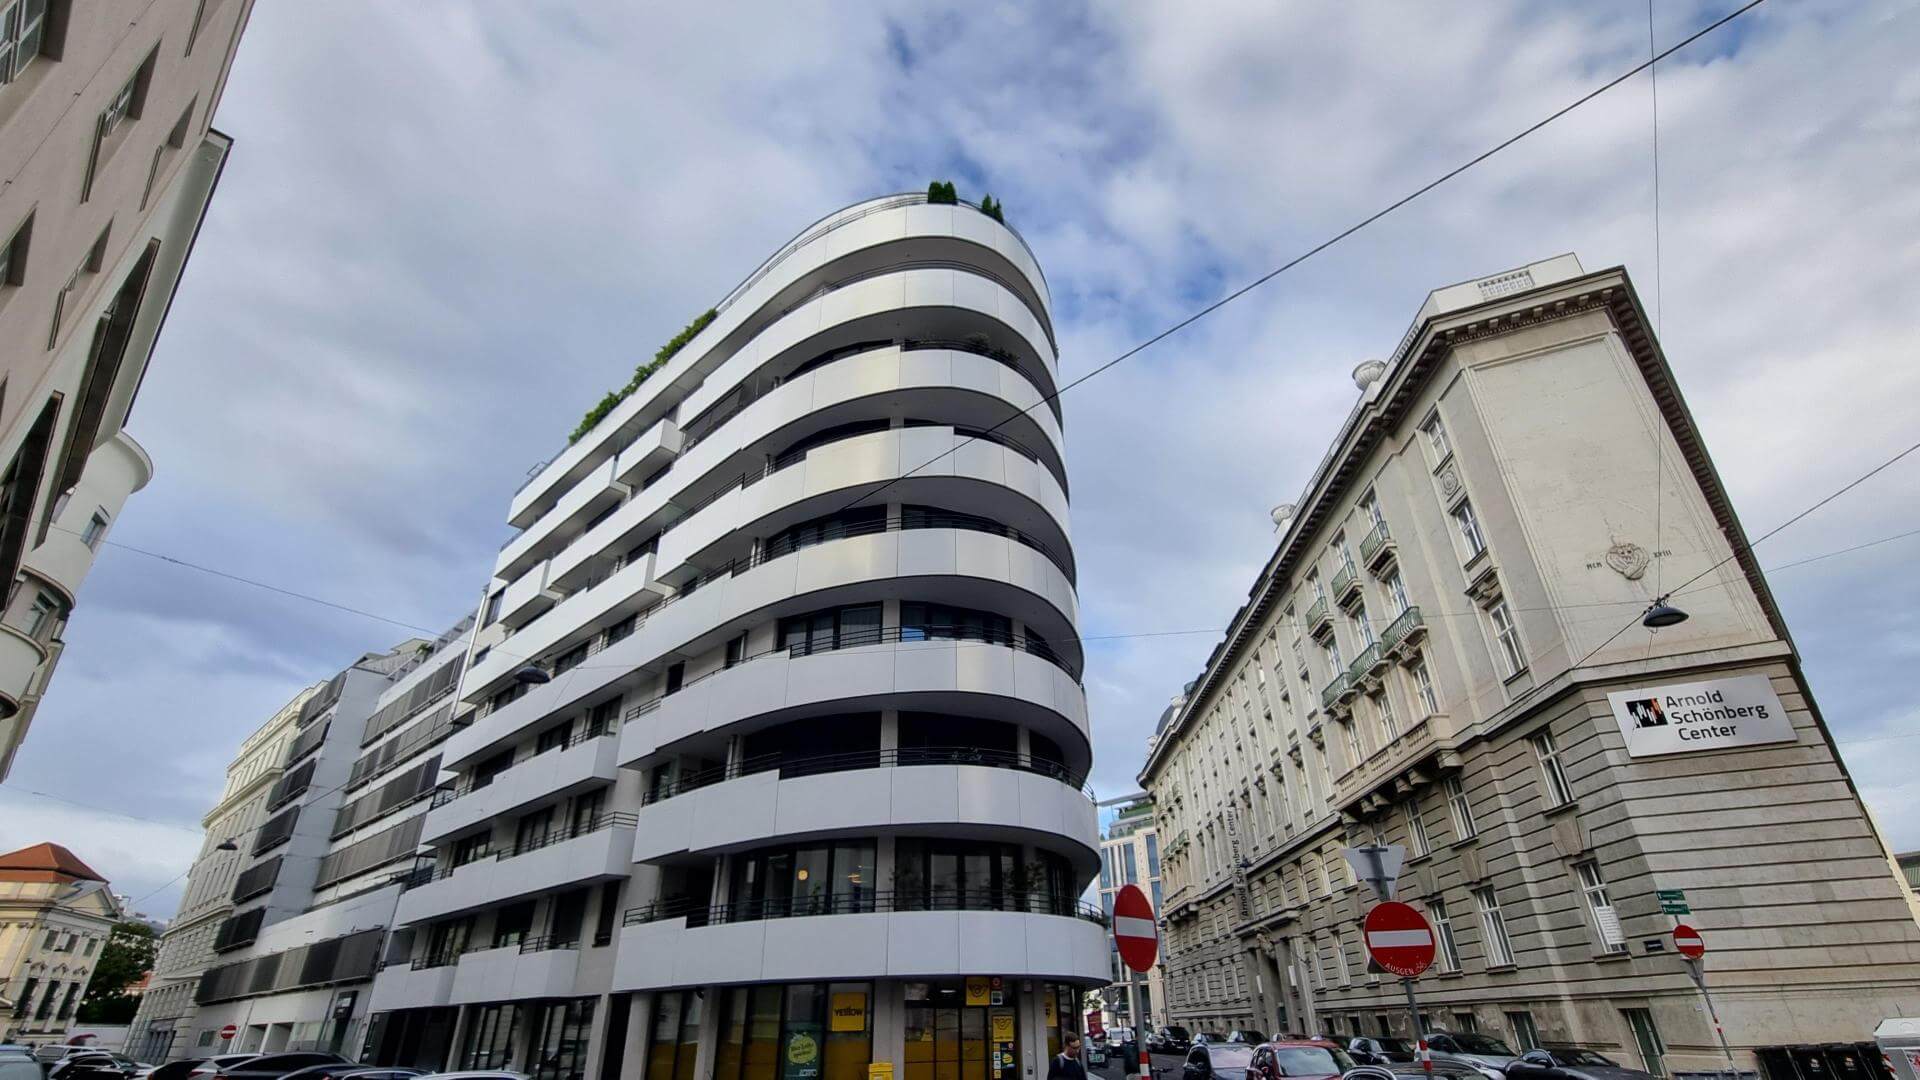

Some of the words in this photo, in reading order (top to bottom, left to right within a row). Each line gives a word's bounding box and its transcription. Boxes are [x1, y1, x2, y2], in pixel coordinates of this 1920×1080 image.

[1665, 689, 1724, 709] Arnold
[1671, 703, 1769, 726] Schönberg
[1678, 724, 1737, 742] Center
[1227, 810, 1236, 837] Center
[1238, 886, 1249, 917] Arnold
